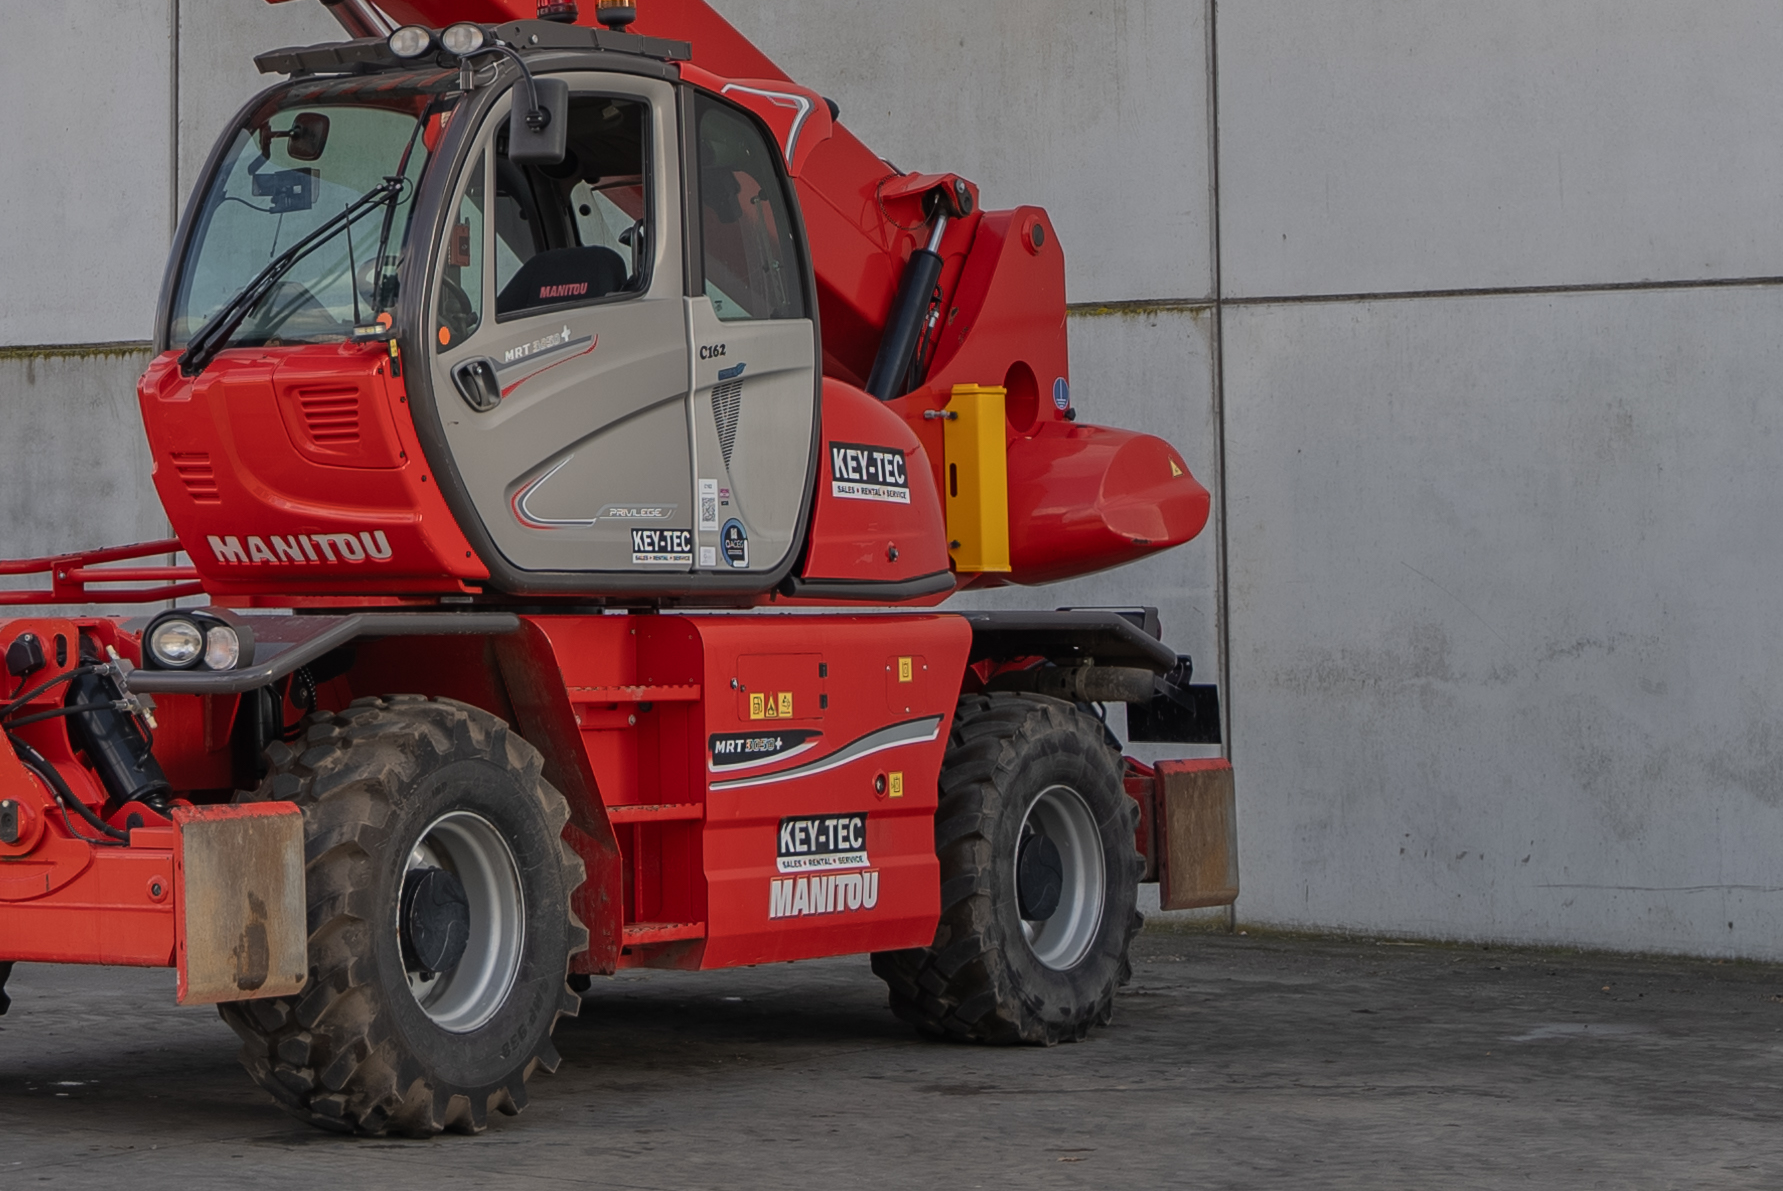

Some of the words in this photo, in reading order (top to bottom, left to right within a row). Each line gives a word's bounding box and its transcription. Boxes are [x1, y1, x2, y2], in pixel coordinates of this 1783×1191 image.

[540, 282, 588, 299] MANITOU
[505, 343, 532, 362] MRT
[700, 344, 726, 360] C162
[833, 448, 905, 484] KEY-TEC
[837, 485, 855, 495] SALES
[861, 487, 882, 497] RENTAL
[886, 490, 907, 500] SERVICE
[609, 508, 663, 517] PRIVILEGE
[206, 530, 394, 565] MANITOU
[632, 530, 691, 551] KEY-TEC
[715, 740, 744, 753] MRT
[780, 817, 863, 854] KEY-TEC
[782, 860, 802, 869] SALES
[808, 857, 832, 867] RENTAL
[838, 855, 865, 865] SERVICE
[769, 869, 879, 919] MANITOU
